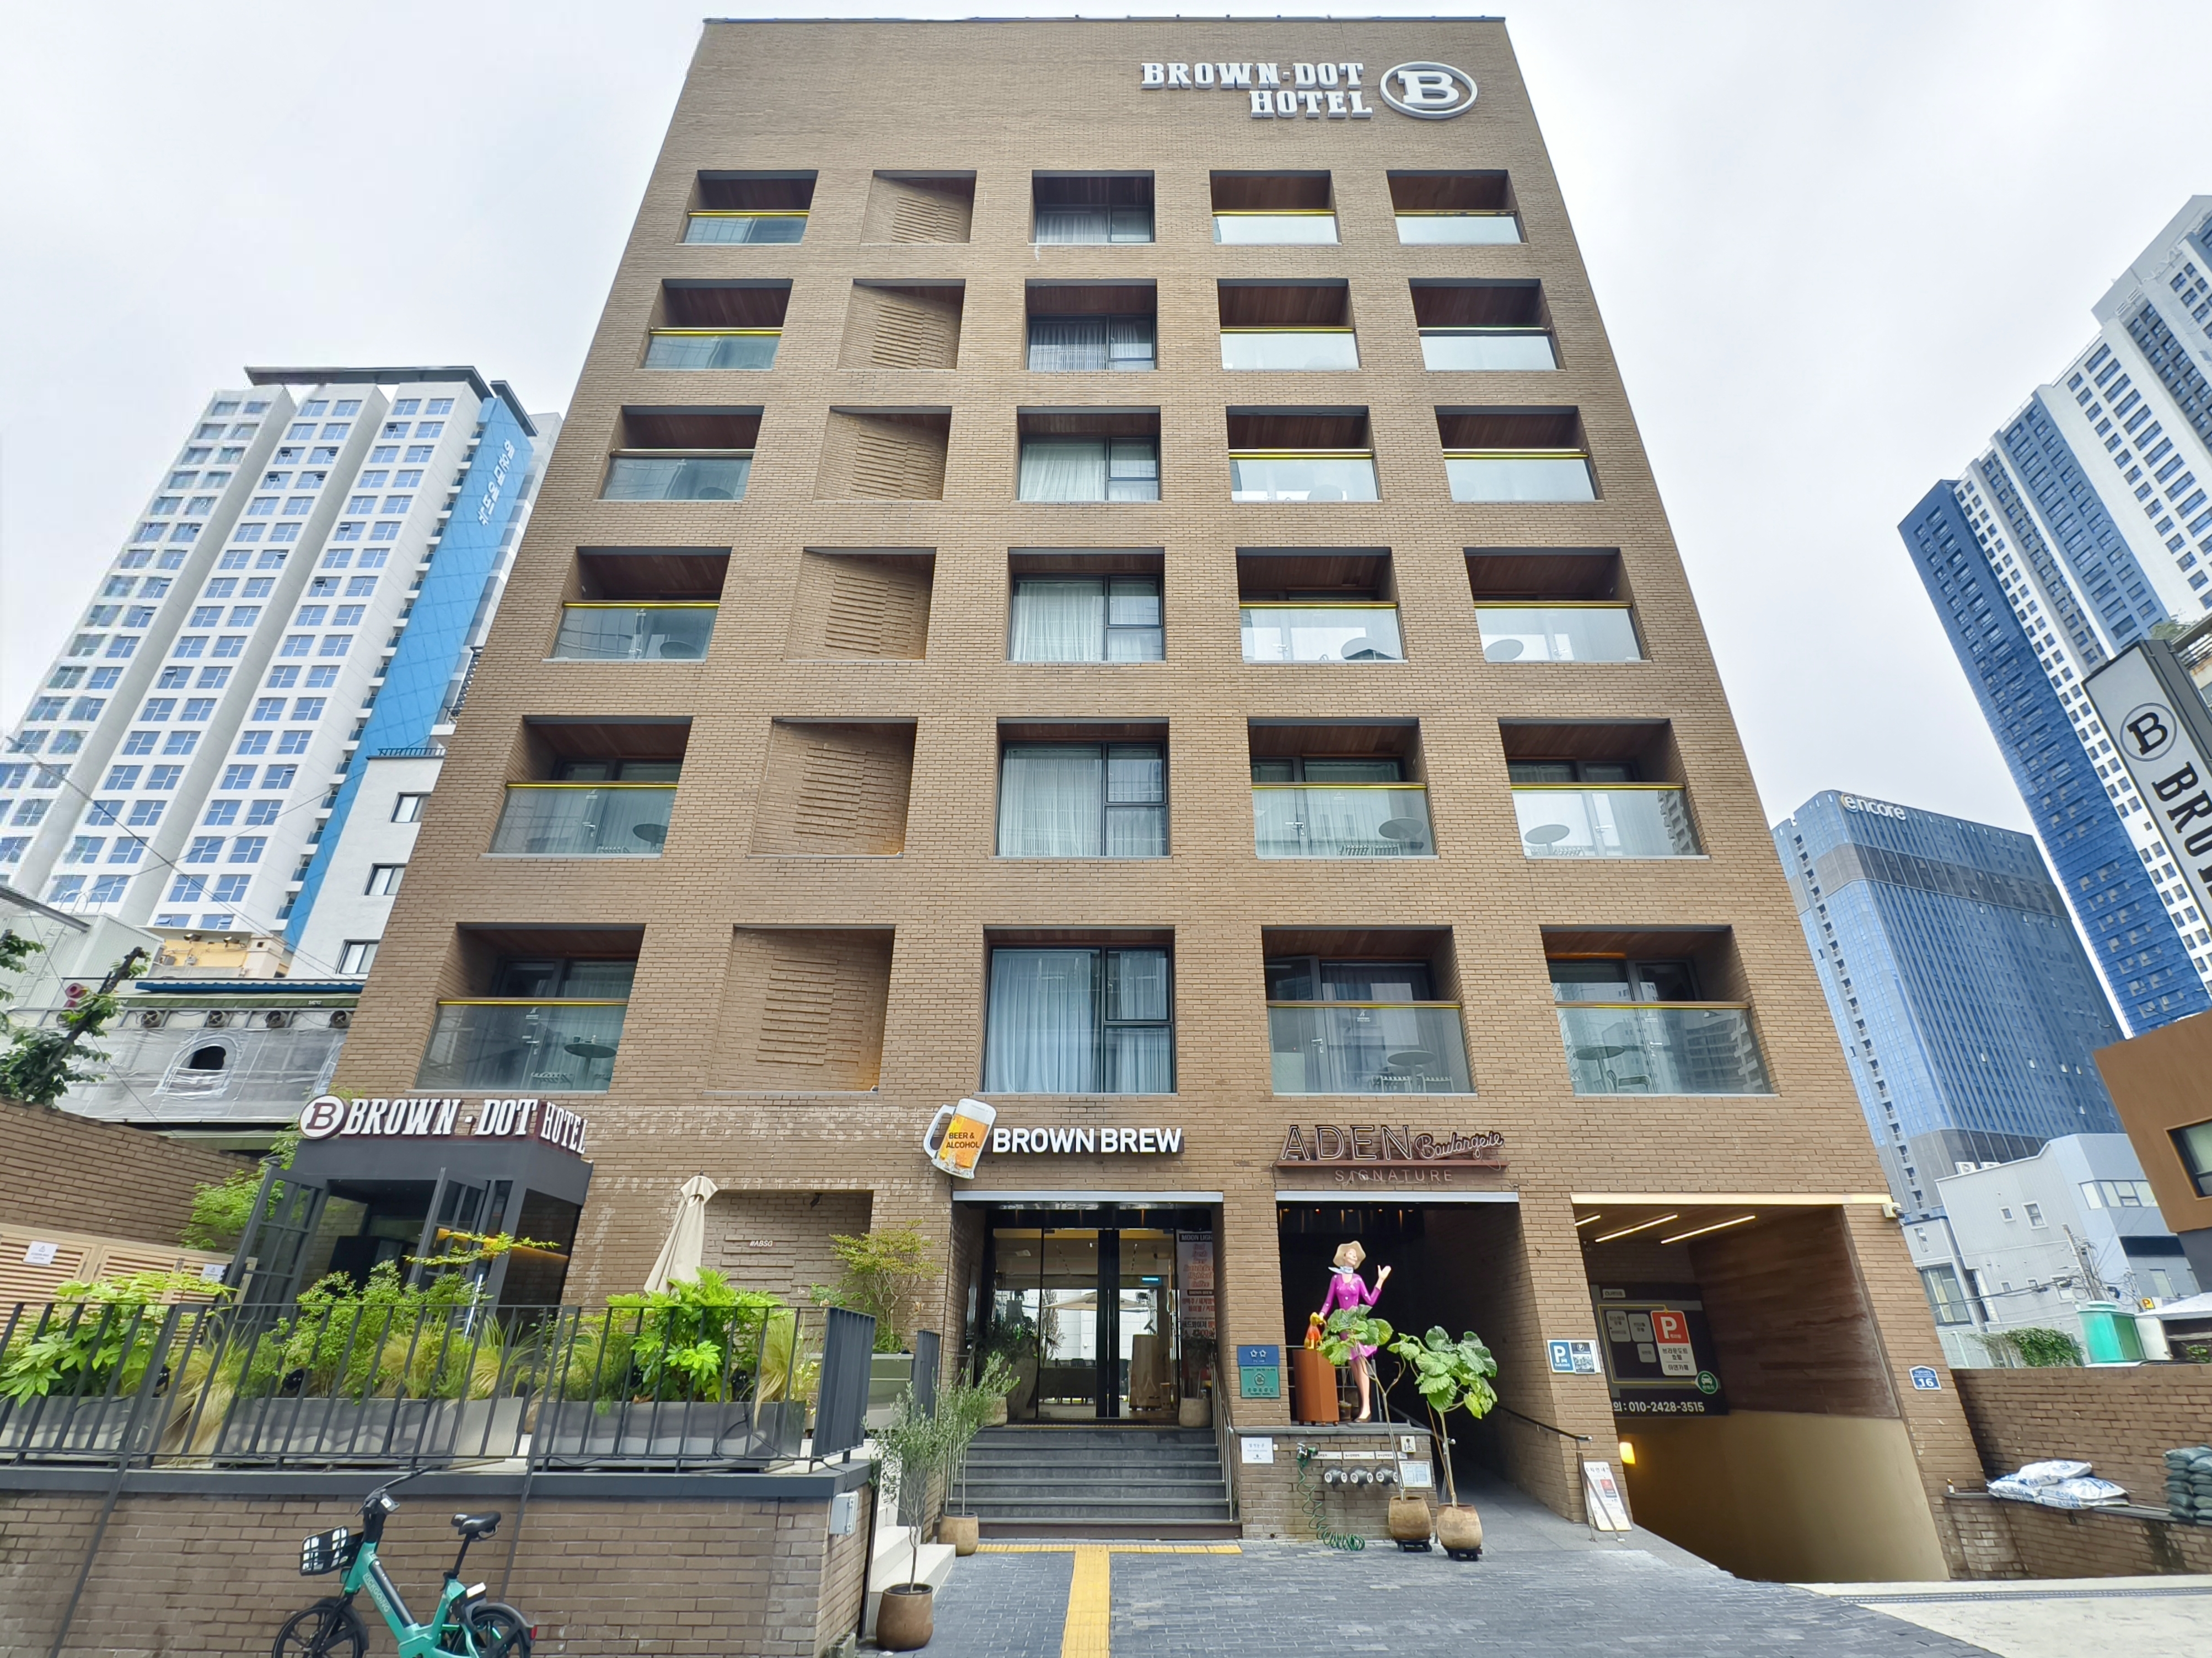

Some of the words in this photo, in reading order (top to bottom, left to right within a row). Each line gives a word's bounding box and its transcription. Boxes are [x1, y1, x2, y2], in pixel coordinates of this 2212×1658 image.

[1249, 90, 1373, 119] HOTEL
[1844, 795, 1907, 821] encore
[538, 1101, 589, 1155] HOTEL
[946, 1141, 980, 1149] ALCOHOL
[992, 1128, 1095, 1153] BROWN
[1100, 1128, 1182, 1153] BREW
[1280, 1124, 1413, 1161] ADEN
[1334, 1169, 1454, 1182] SIGNATURE
[2142, 1299, 2151, 1308] P
[1660, 1316, 1678, 1339] P
[1553, 1345, 1566, 1363] P
[1918, 1378, 1934, 1387] 16
[1629, 1401, 1705, 1412] 010-2428-3515
